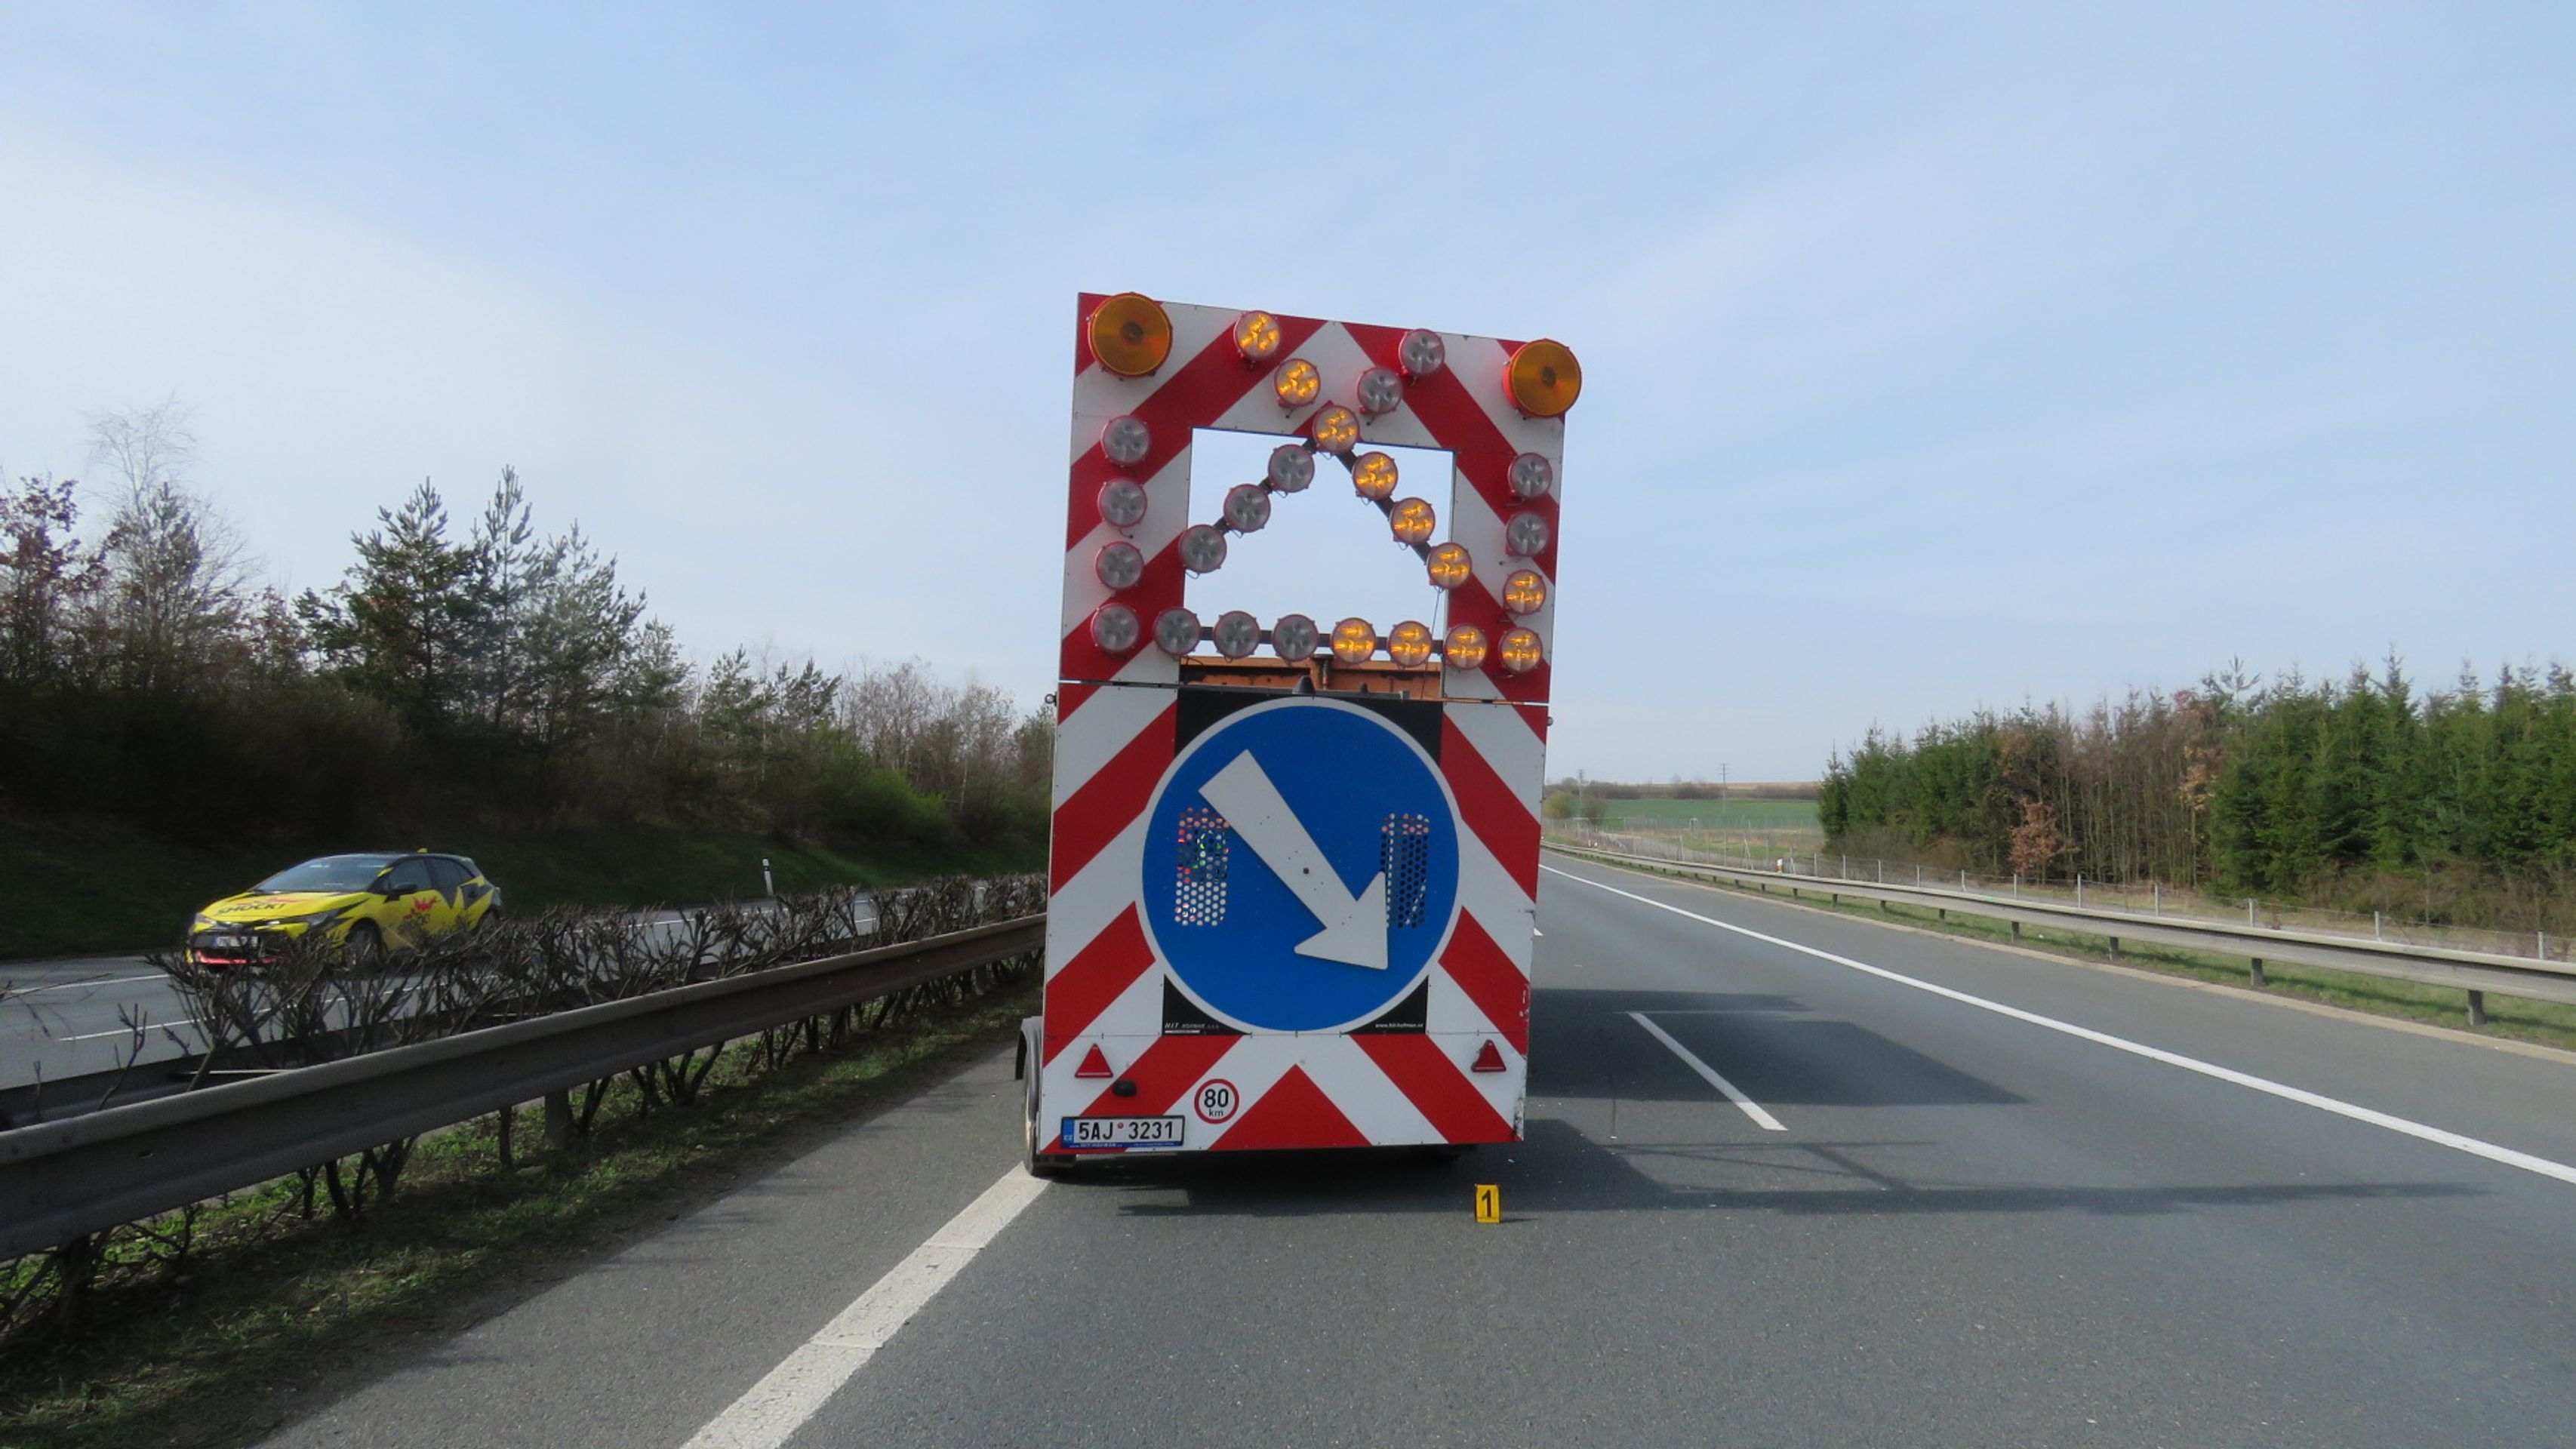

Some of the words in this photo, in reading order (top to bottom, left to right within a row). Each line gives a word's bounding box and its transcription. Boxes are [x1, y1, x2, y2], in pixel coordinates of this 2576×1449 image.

[1204, 1088, 1229, 1108] 80
[1208, 1108, 1223, 1117] km
[1079, 1121, 1113, 1140] 5AJ
[1128, 1121, 1173, 1140] 3231
[1482, 1189, 1491, 1218] 1
